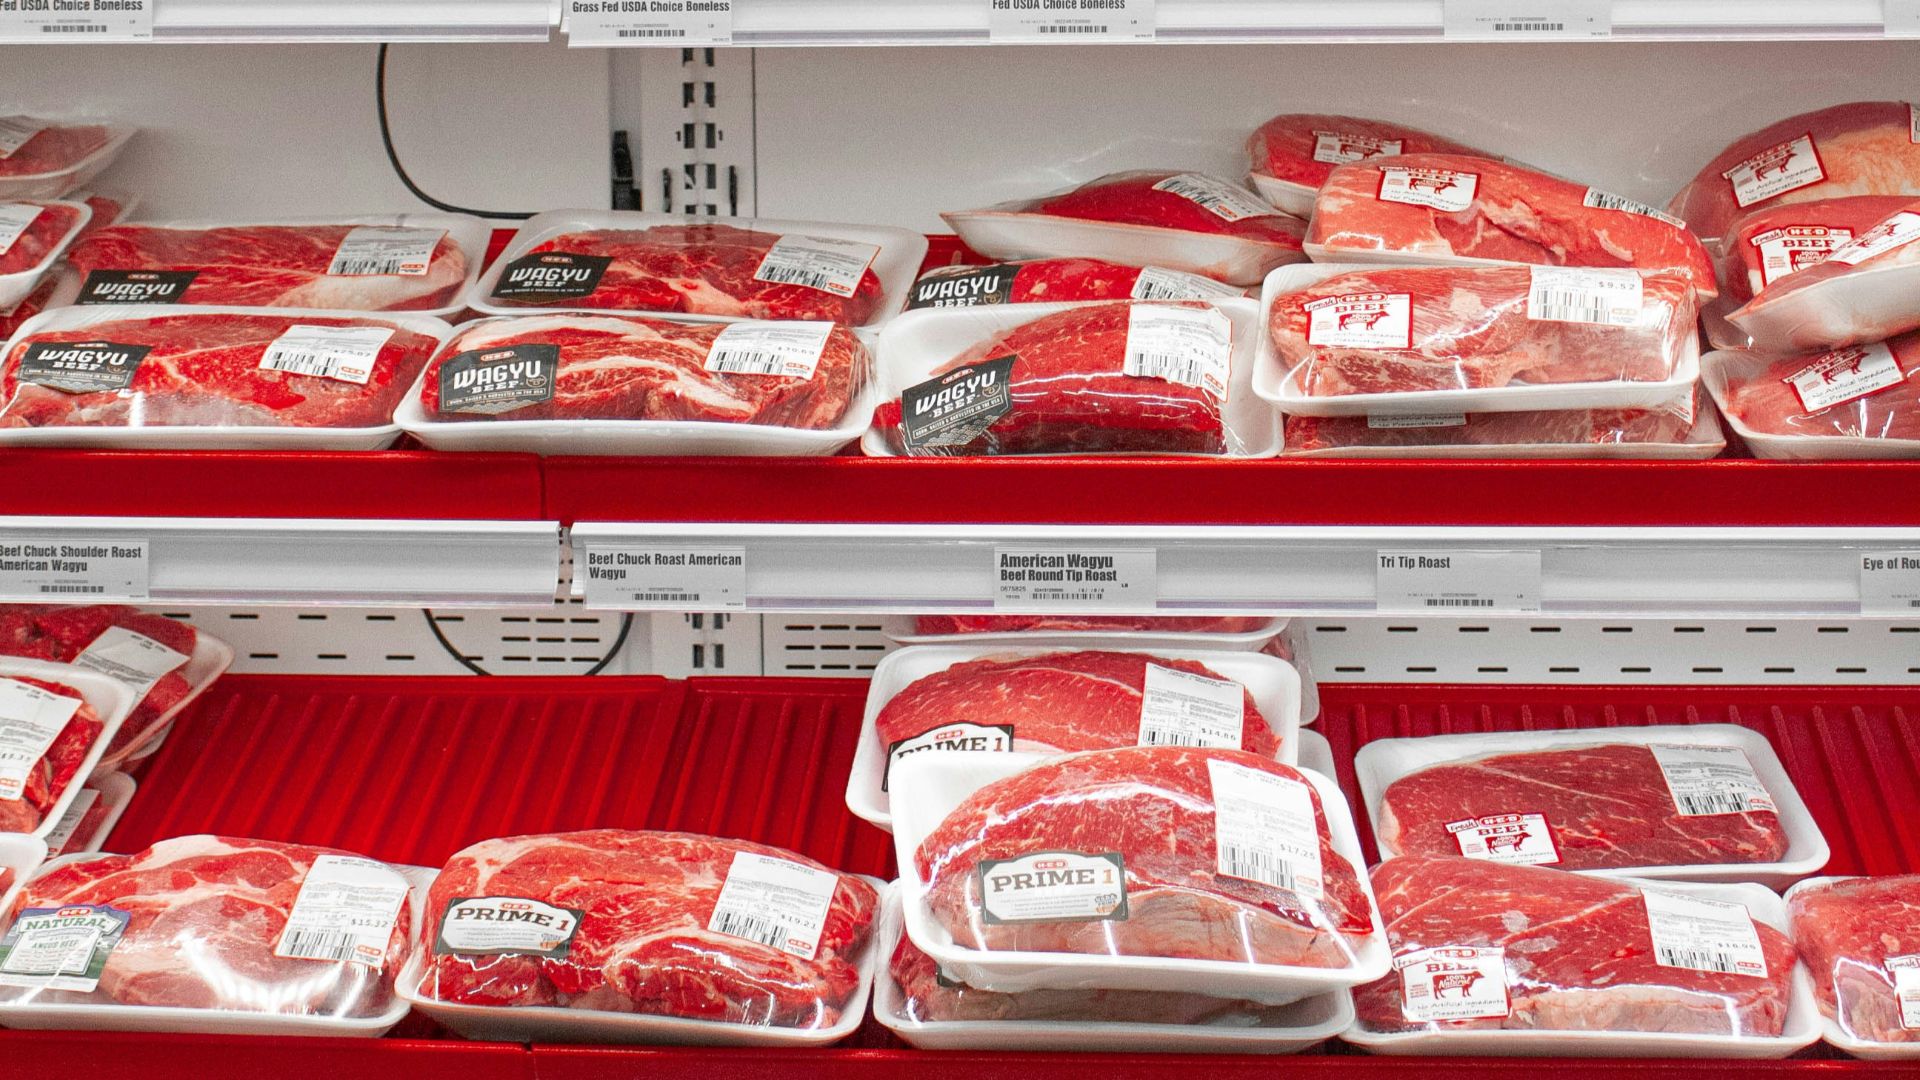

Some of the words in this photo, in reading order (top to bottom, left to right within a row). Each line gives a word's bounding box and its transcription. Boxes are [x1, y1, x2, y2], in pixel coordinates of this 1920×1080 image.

[20, 0, 49, 11] USDA
[53, 0, 90, 11] Choice
[93, 0, 143, 11] Boneless
[572, 1, 599, 13] Grass
[602, 1, 619, 12] Fed
[622, 1, 647, 12] USDA
[650, 1, 683, 12] Choice
[686, 0, 730, 12] Boneless
[992, 0, 1010, 10] Fed
[1014, 0, 1040, 10] USDA
[1043, 0, 1077, 10] Choice
[1080, 0, 1125, 9] Boneless
[1782, 239, 1835, 248] BEEF
[509, 268, 592, 282] WAGYU
[92, 283, 177, 295] WAGYU
[918, 276, 1000, 302] WAGYU
[934, 297, 978, 308] BEEF
[1334, 304, 1387, 313] BEEF
[38, 350, 129, 366] WAGYU
[52, 362, 102, 371] BEEF
[454, 360, 541, 390] WAGYU
[472, 380, 519, 394] BEEF
[916, 370, 997, 416] WAGYU
[933, 394, 976, 418] BEEF
[24, 545, 57, 558] Chuck
[60, 546, 108, 558] Shoulder
[112, 546, 142, 558] Roast
[589, 553, 614, 565] Beef
[617, 553, 651, 565] Chuck
[654, 554, 686, 566] Roast
[688, 554, 742, 566] American
[1000, 554, 1065, 568] American
[1067, 554, 1113, 569] Wagyu
[1380, 556, 1395, 568] Tri
[1398, 556, 1416, 570] Tip
[1418, 556, 1451, 569] Roast
[1864, 558, 1884, 571] Eye
[1887, 557, 1898, 569] of
[51, 560, 88, 573] Wagyu
[589, 567, 627, 580] Wagyu
[1000, 570, 1026, 581] Beef
[1028, 570, 1064, 581] Round
[1066, 570, 1083, 582] Tip
[1086, 570, 1117, 582] Roast
[993, 737, 1003, 752] 1
[1477, 824, 1528, 836] BEEF
[992, 869, 1095, 893] PRIME
[1103, 870, 1114, 885] 1
[26, 917, 107, 931] NATURAL
[454, 908, 554, 927] PRIME
[556, 920, 570, 932] 1
